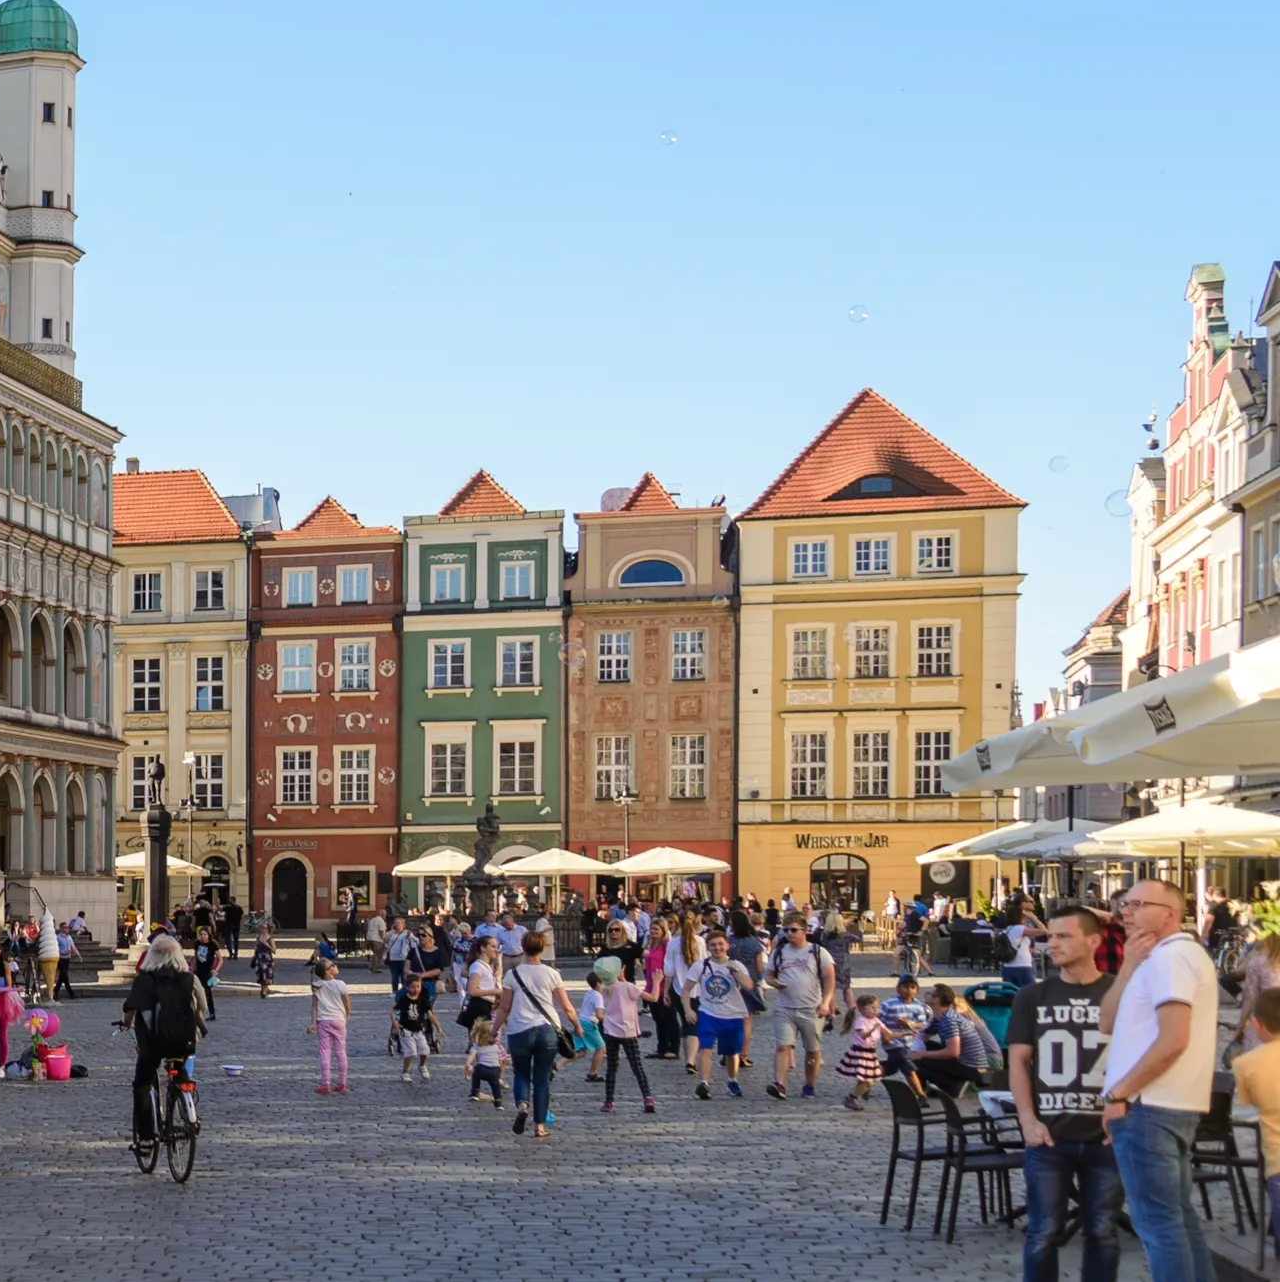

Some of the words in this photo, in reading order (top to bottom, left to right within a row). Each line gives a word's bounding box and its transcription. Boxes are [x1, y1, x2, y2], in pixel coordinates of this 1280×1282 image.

[274, 838, 293, 847] Bank
[294, 838, 317, 847] Pekao
[795, 833, 852, 849] WHISKEY
[854, 835, 862, 843] IN
[864, 832, 889, 847] JAR
[1037, 1006, 1101, 1024] LUCK
